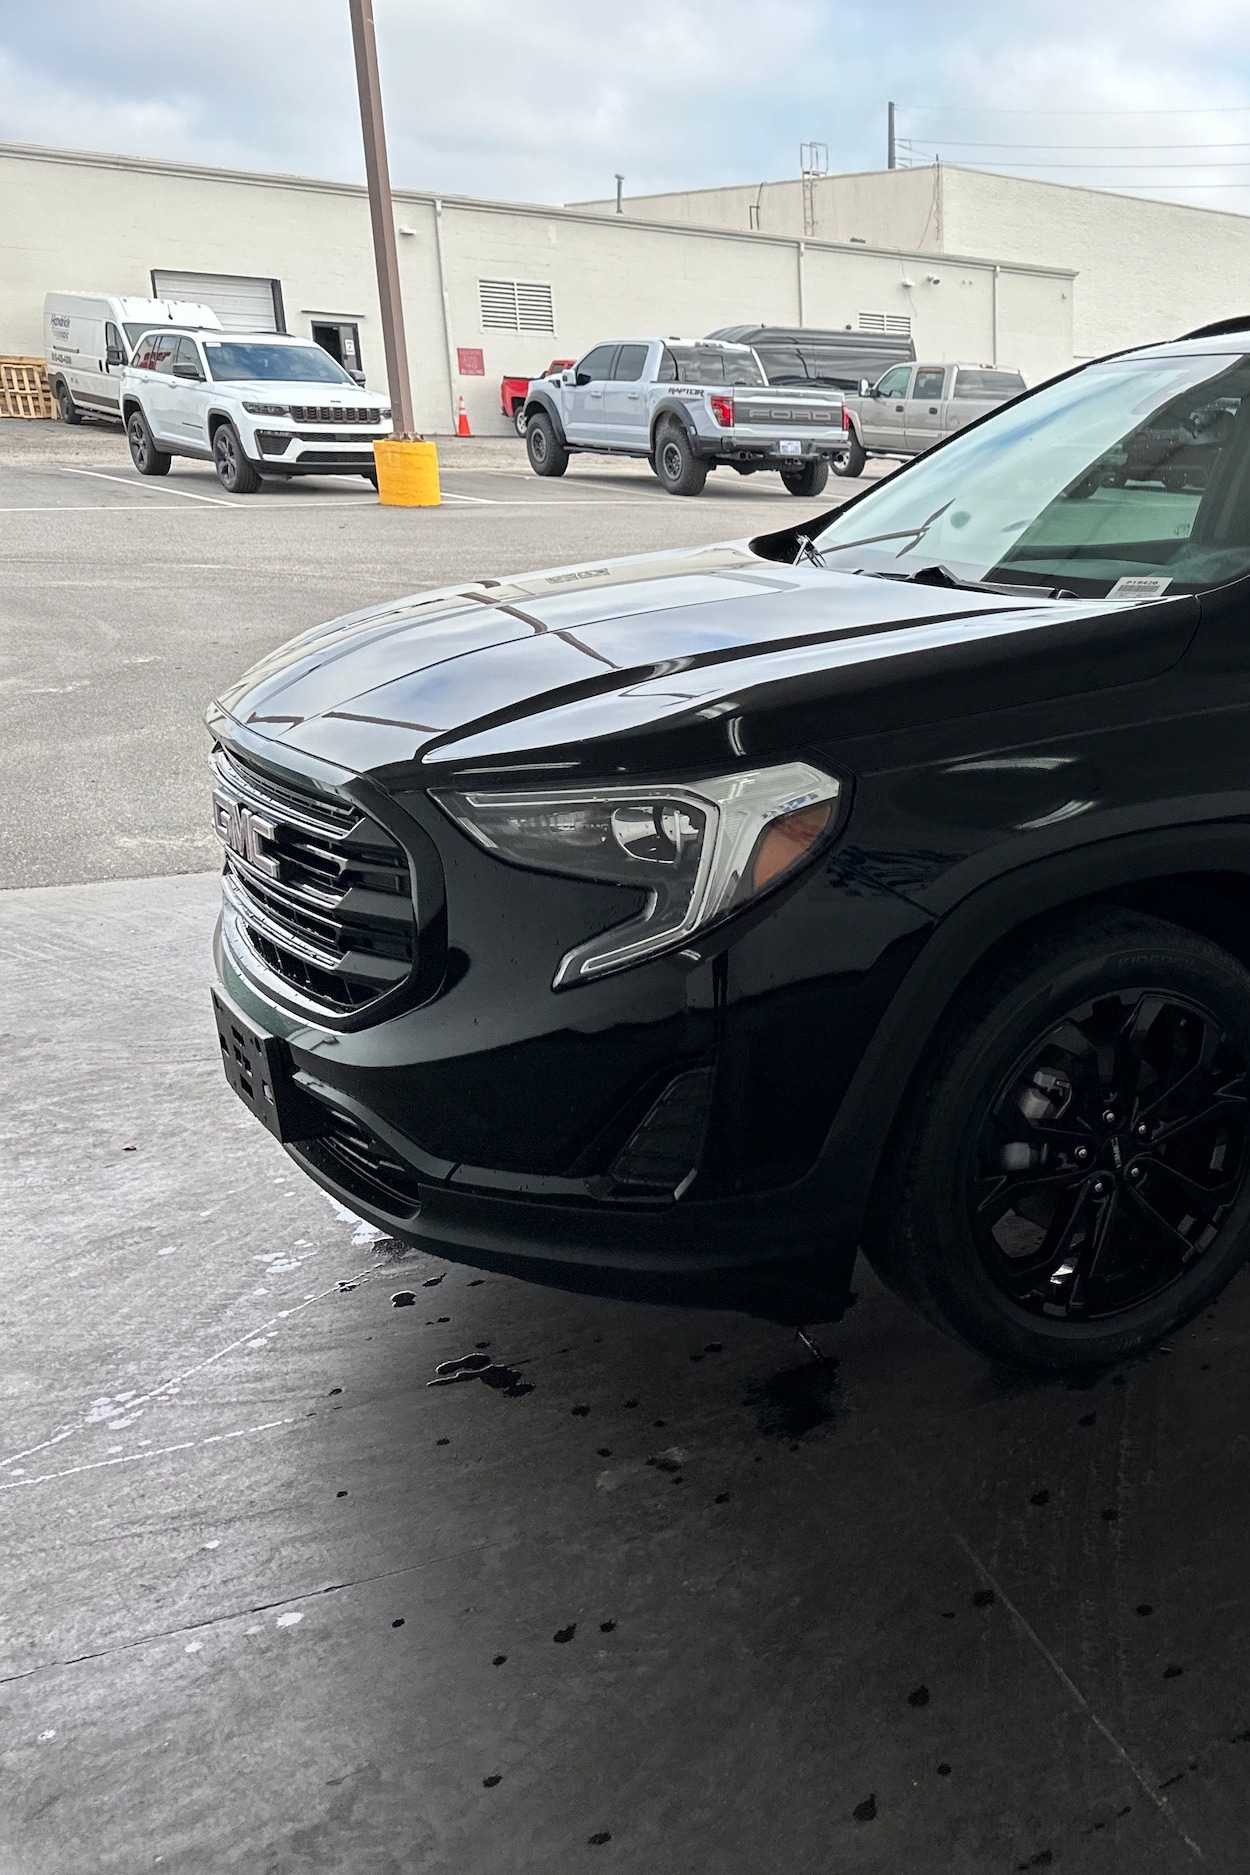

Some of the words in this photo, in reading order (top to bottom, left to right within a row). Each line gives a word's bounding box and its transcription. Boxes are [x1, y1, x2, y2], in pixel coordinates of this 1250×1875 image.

[668, 387, 704, 398] RAPTOR
[749, 409, 832, 421] FORD
[212, 788, 280, 879] GMC
